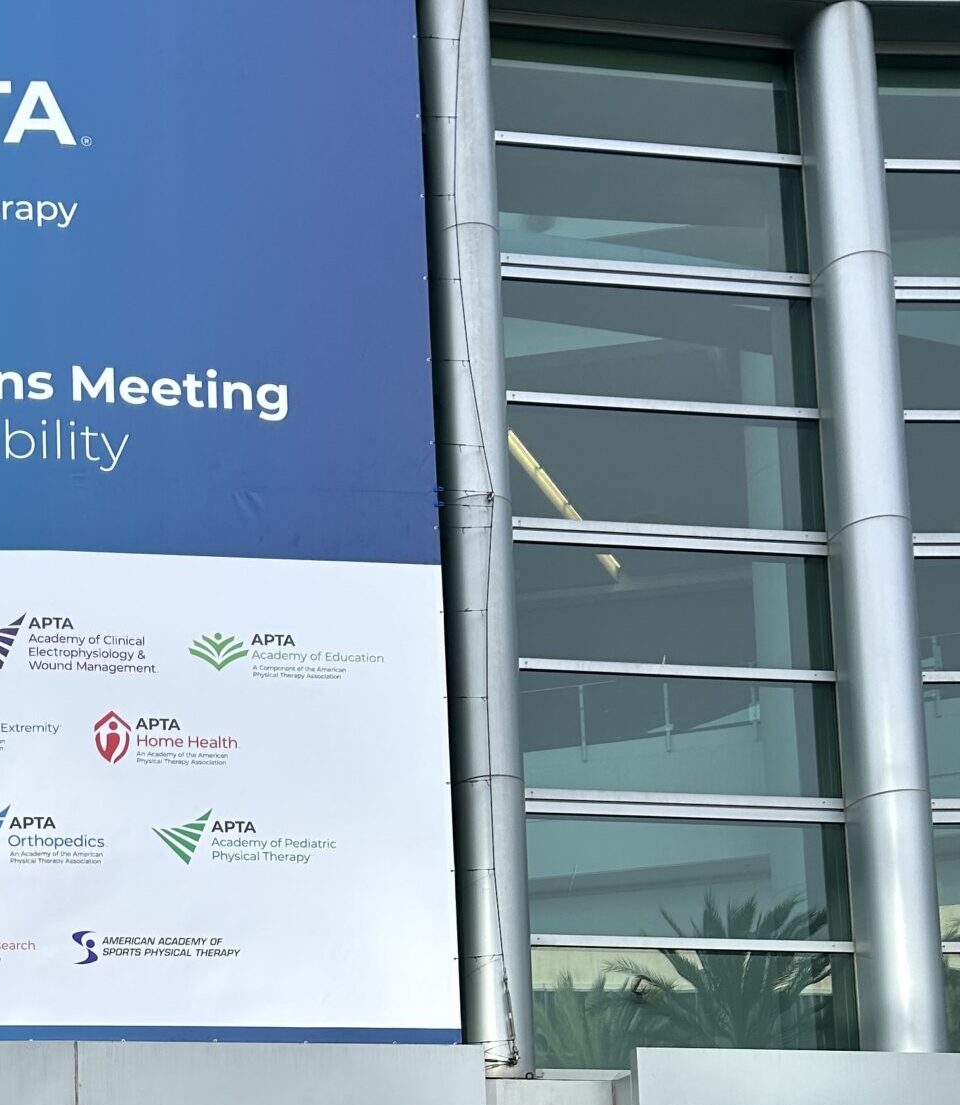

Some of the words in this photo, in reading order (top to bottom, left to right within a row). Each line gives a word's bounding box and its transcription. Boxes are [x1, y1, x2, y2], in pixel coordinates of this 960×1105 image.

[72, 365, 289, 421] Meeting
[28, 617, 74, 630] APTA
[28, 633, 86, 647] Academy
[88, 634, 100, 644] of
[103, 635, 145, 646] Clinical
[251, 634, 296, 647] APTA
[28, 646, 134, 663] Electrophysiology
[137, 650, 146, 660] &
[251, 649, 307, 663] Academy
[310, 651, 322, 661] of
[325, 652, 384, 663] Education
[28, 660, 72, 671] Wound
[76, 661, 156, 674] Management
[0, 722, 60, 735] Extremity
[135, 718, 181, 731] APTA
[137, 734, 184, 747] Home
[188, 736, 238, 749] Health
[9, 817, 56, 829] APTA
[211, 821, 256, 833] APTA
[7, 834, 105, 849] Orthopedics
[211, 837, 268, 850] Academy
[270, 838, 282, 848] of
[284, 838, 336, 849] Pediatric
[212, 850, 260, 863] Physical
[262, 851, 311, 864] Therapy
[102, 937, 156, 945] AMERICAN
[158, 937, 208, 945] ACADEMY
[210, 938, 223, 946] OF
[102, 948, 142, 956] SPORTS
[144, 948, 192, 957] PHYSICAL
[195, 949, 240, 957] THERAPY
